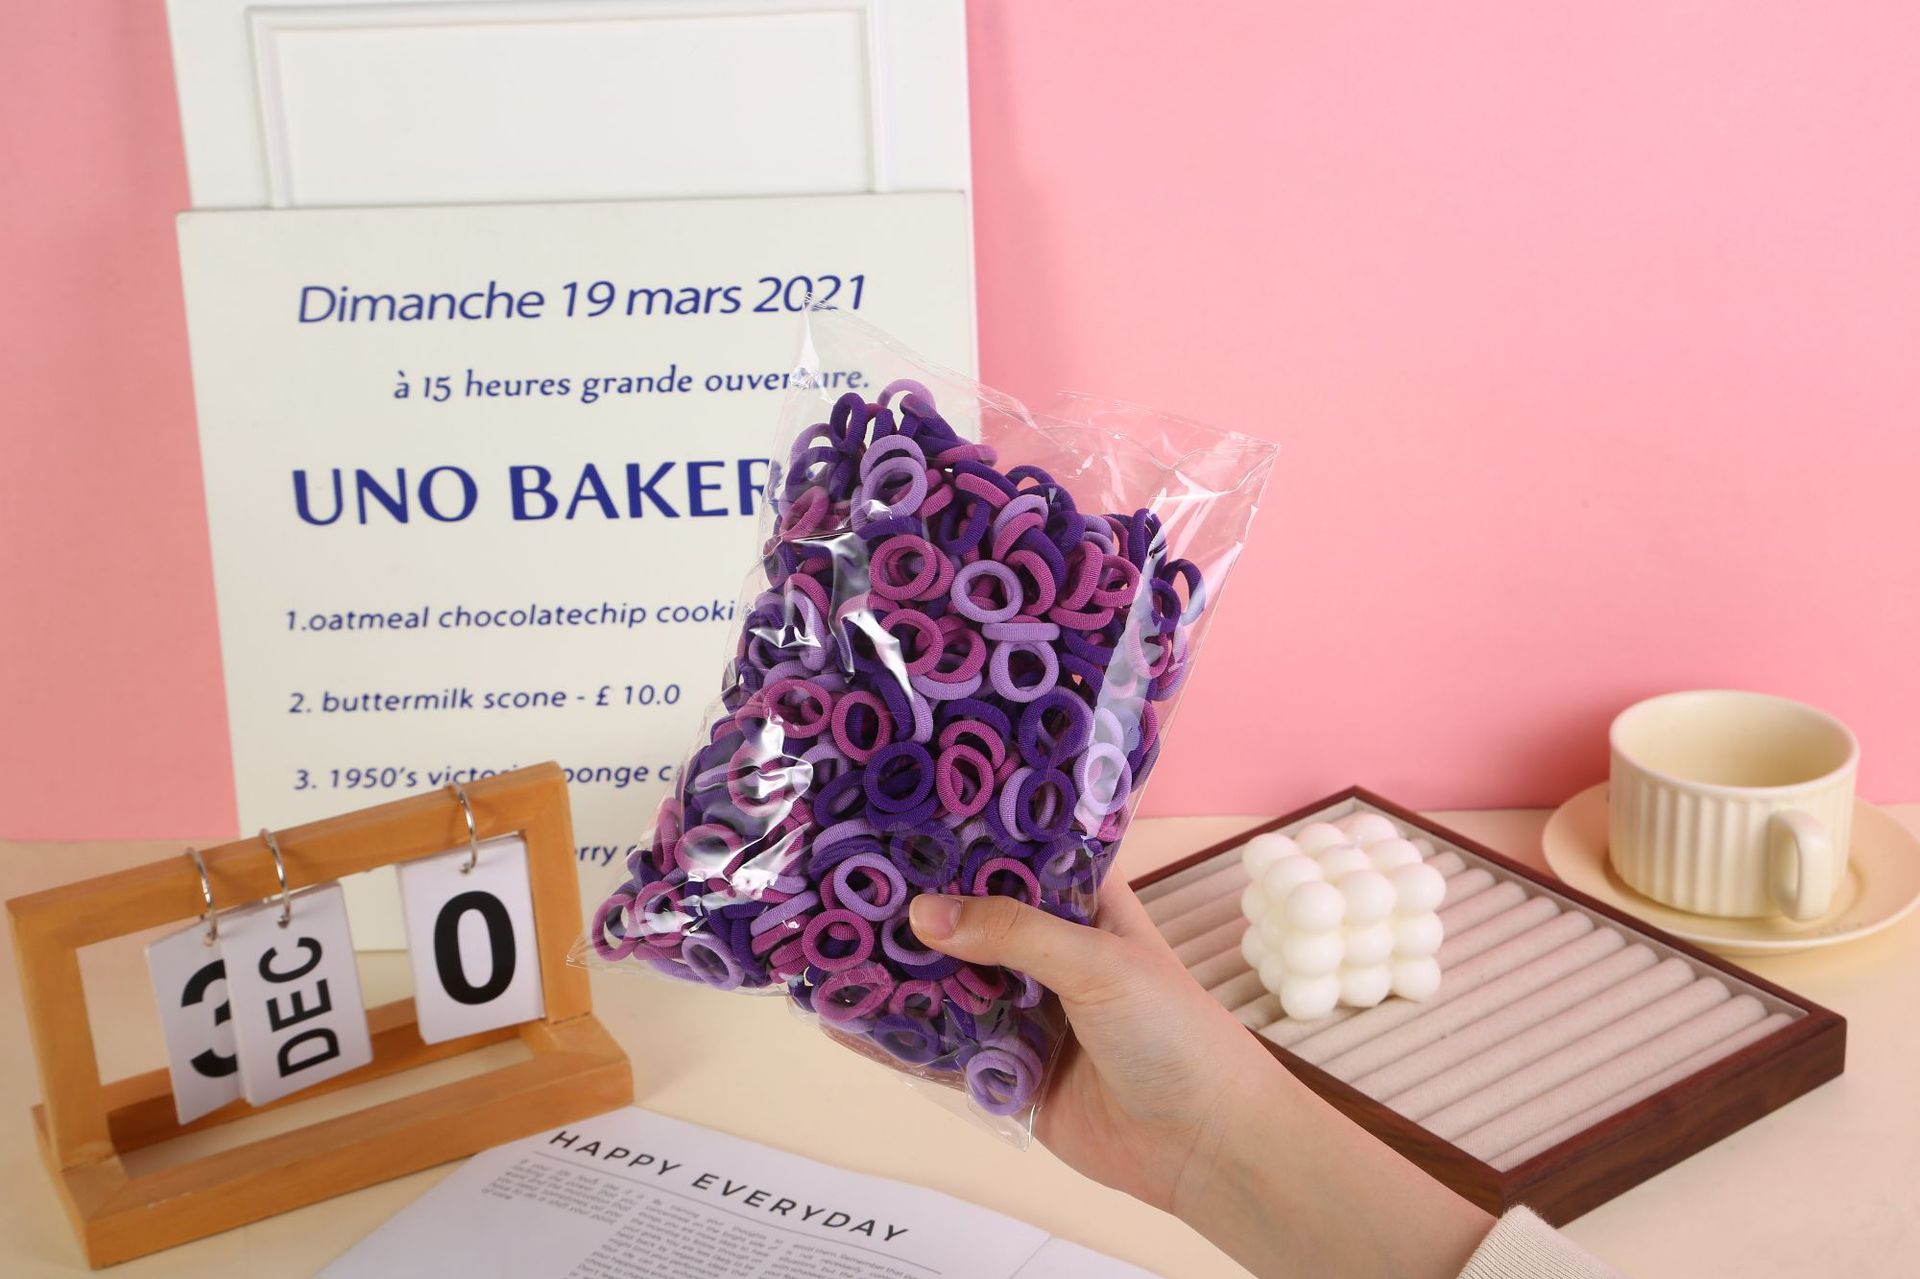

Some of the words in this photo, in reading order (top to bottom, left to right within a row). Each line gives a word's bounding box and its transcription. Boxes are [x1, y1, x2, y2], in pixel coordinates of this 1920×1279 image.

[299, 280, 546, 326] Dimanche
[562, 279, 618, 319] 19
[625, 283, 744, 318] mars
[752, 273, 866, 313] 2021
[394, 370, 411, 401] à
[424, 376, 453, 404] 15
[466, 368, 572, 399] heures
[581, 364, 694, 405] grande
[293, 465, 480, 527] UNO
[509, 458, 771, 522] BAKER
[438, 599, 648, 630] chocolatechip
[289, 691, 313, 716] 2.
[322, 688, 475, 714] buttermilk
[484, 690, 567, 711] scone
[623, 683, 682, 706] 10.0
[294, 768, 318, 791] 3.
[330, 766, 418, 790] 1950's
[433, 890, 517, 1006] 0
[258, 936, 340, 1078] DEC
[549, 1130, 681, 1176] HAPPY
[691, 1173, 909, 1243] EVERYDAY
